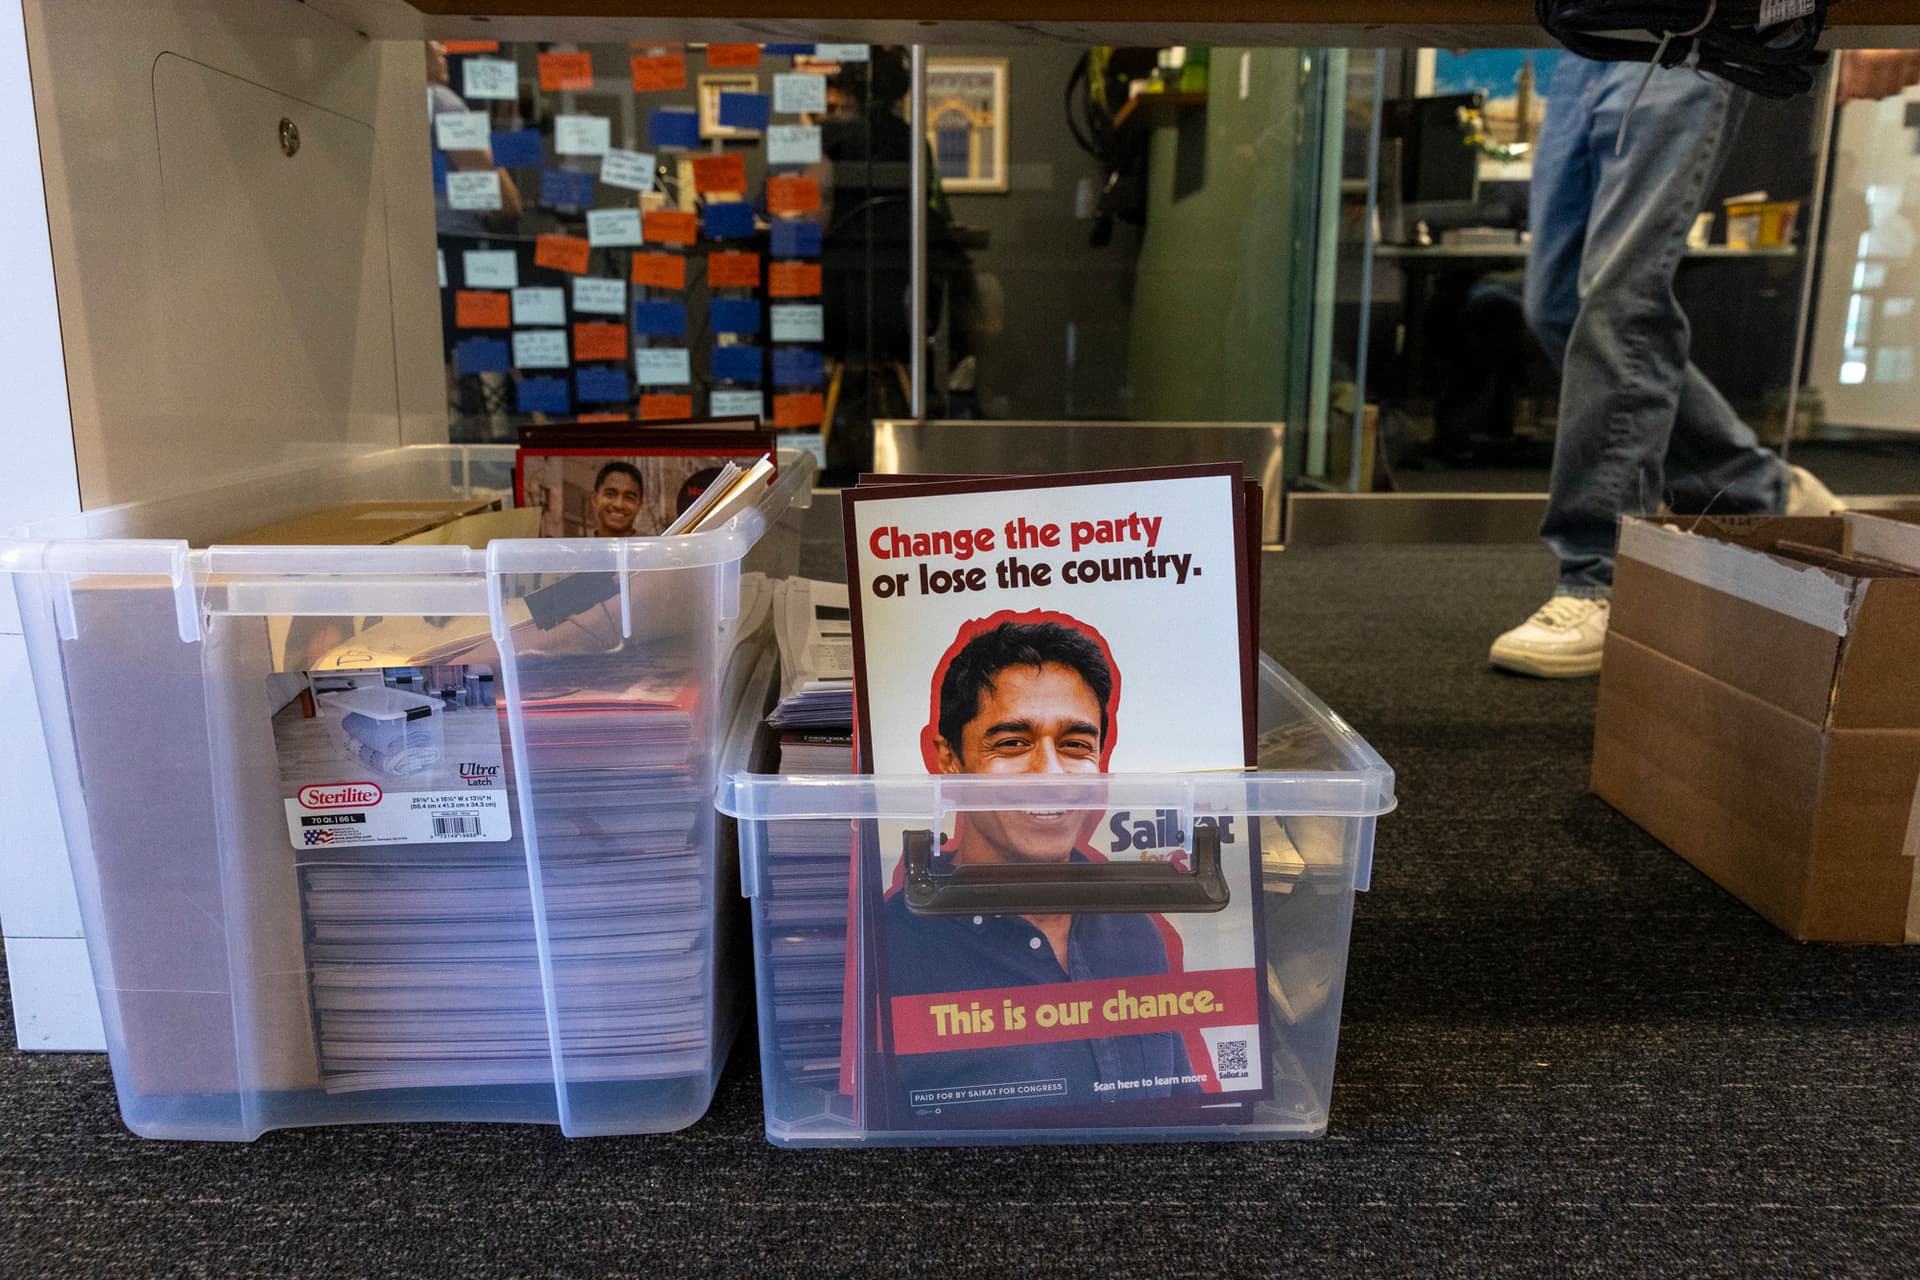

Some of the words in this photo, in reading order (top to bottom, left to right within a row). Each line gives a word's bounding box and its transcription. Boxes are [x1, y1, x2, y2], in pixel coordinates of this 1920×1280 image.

[869, 526, 995, 560] Change
[1004, 517, 1060, 549] the
[1070, 511, 1162, 552] party
[872, 573, 909, 598] or
[919, 563, 987, 595] lose
[996, 556, 1052, 588] the
[1061, 549, 1202, 584] country.
[459, 762, 496, 776] Ultra
[467, 778, 493, 787] Latch
[929, 1002, 995, 1036] This
[1003, 999, 1026, 1031] is
[1035, 999, 1093, 1028] our
[1102, 989, 1224, 1022] chance.
[914, 1094, 935, 1102] PAID
[955, 1091, 967, 1099] BY
[968, 1089, 997, 1098] SAIKAT
[999, 1087, 1015, 1095] FOR
[1017, 1083, 1063, 1094] CONGRESS
[1093, 1082, 1116, 1092] Scan
[1117, 1079, 1140, 1089] here
[1142, 1078, 1153, 1087] to
[1154, 1076, 1180, 1086] learn
[1181, 1074, 1207, 1084] more
